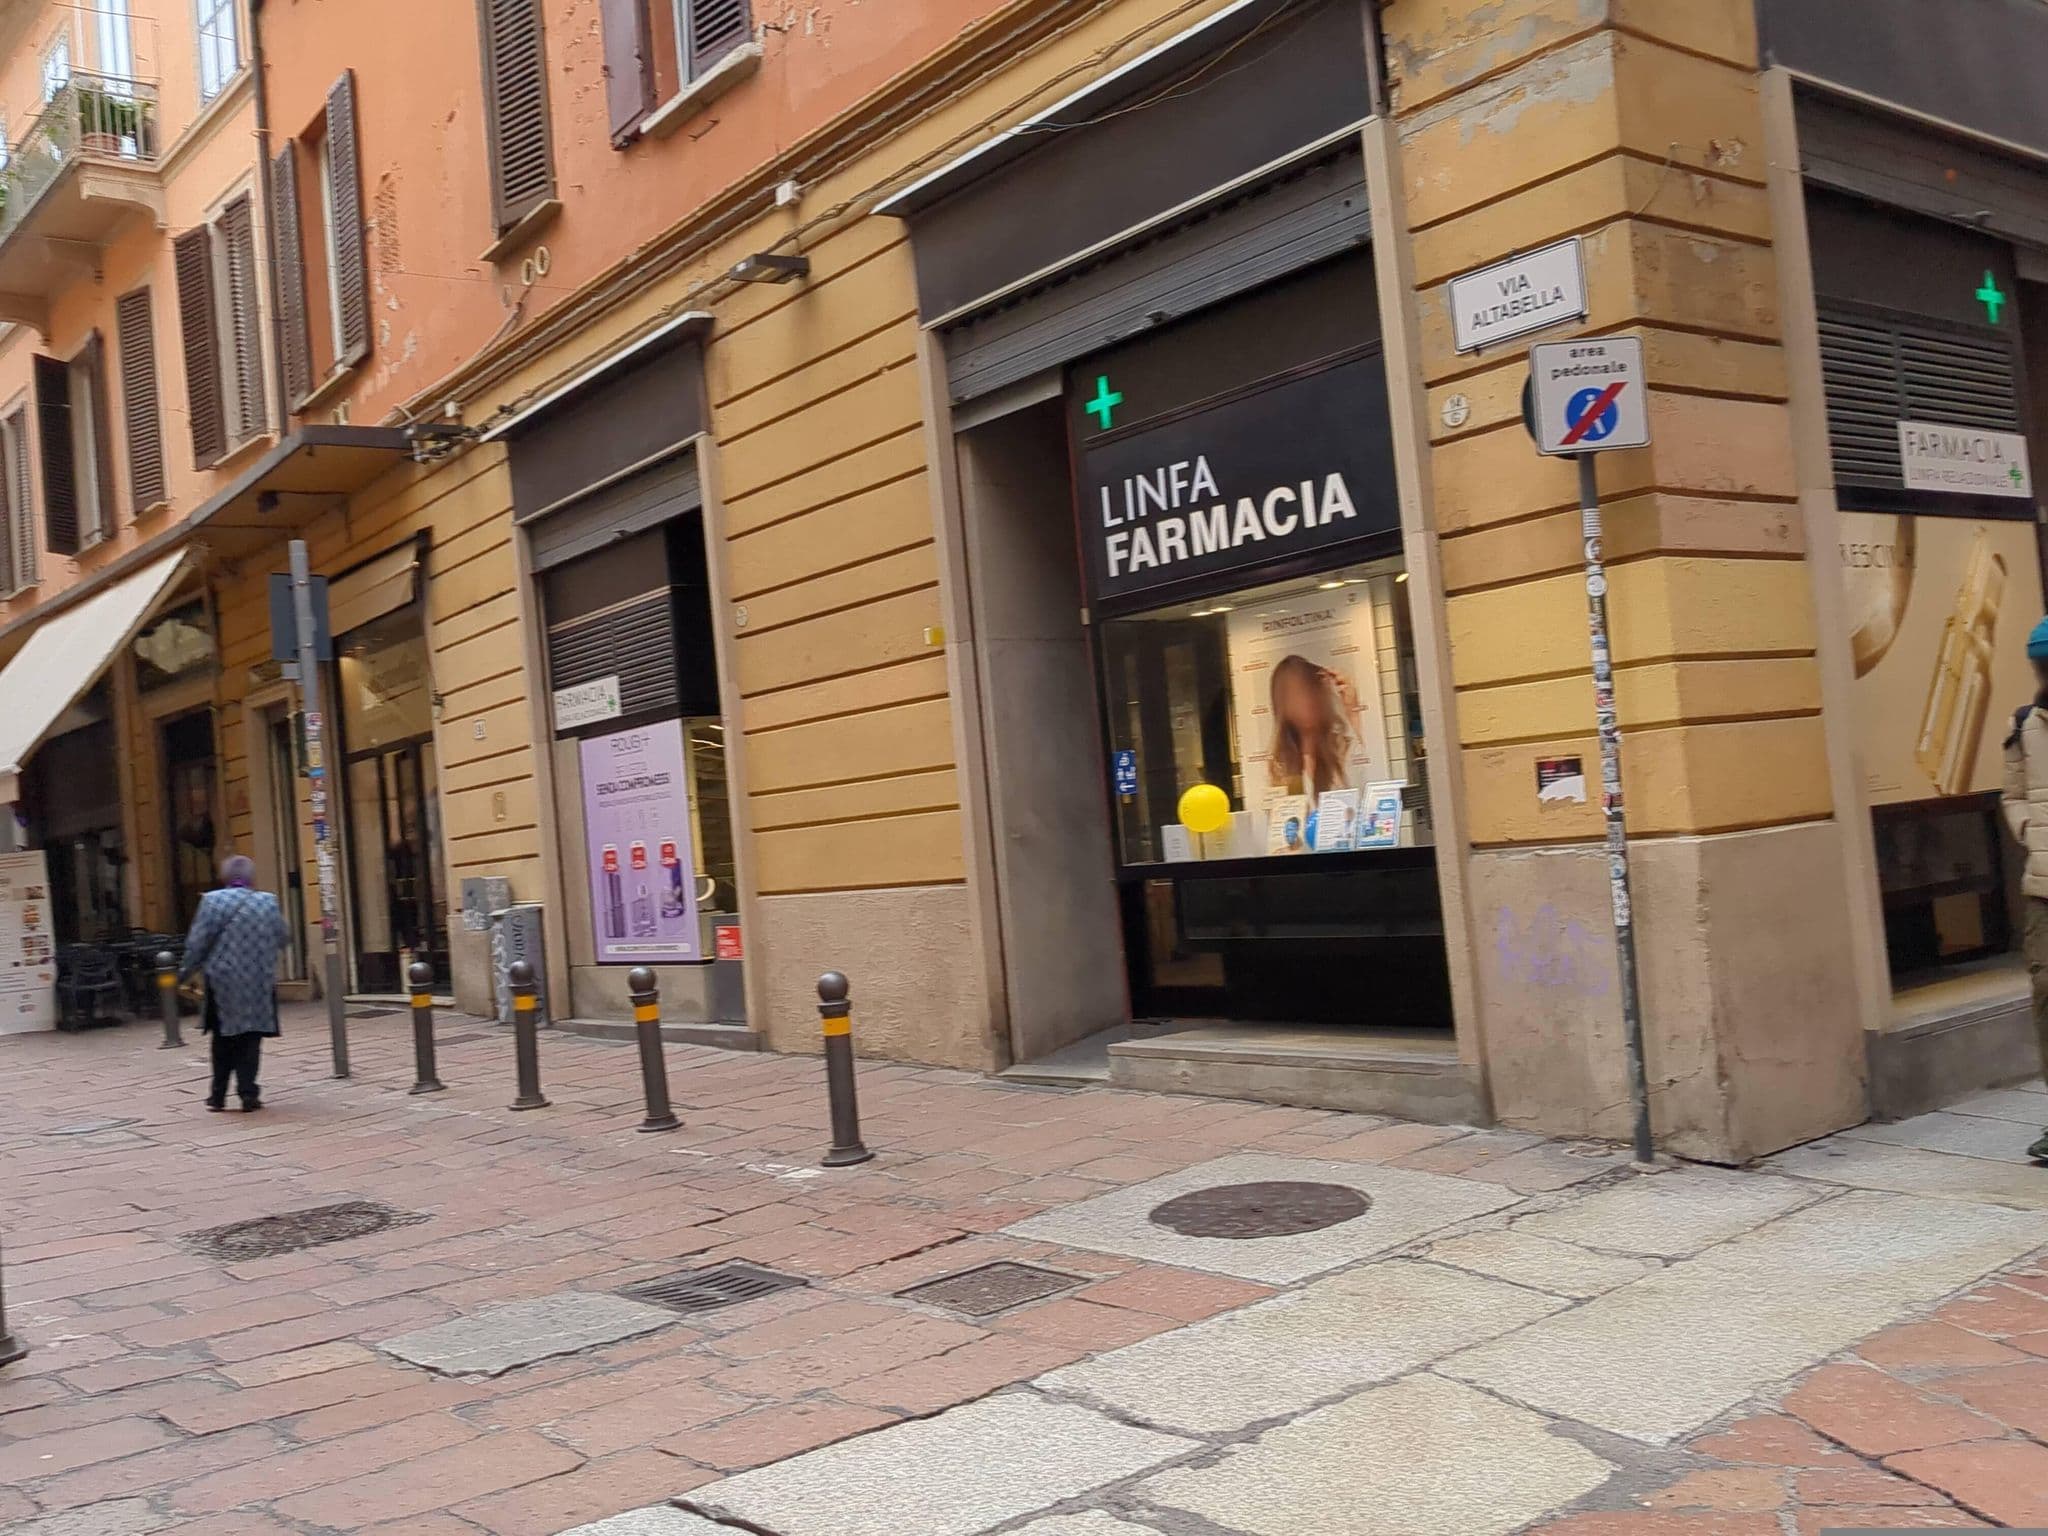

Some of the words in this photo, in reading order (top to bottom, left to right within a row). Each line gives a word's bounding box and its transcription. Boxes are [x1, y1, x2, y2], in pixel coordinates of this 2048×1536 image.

[1497, 274, 1531, 297] VIA
[1471, 286, 1566, 331] ALTABELLA
[1569, 345, 1606, 358] area
[1551, 361, 1628, 381] pedonale
[1904, 430, 2008, 465] FARMACIA
[1101, 455, 1220, 528] LINFA
[1105, 472, 1358, 577] FARMACIA
